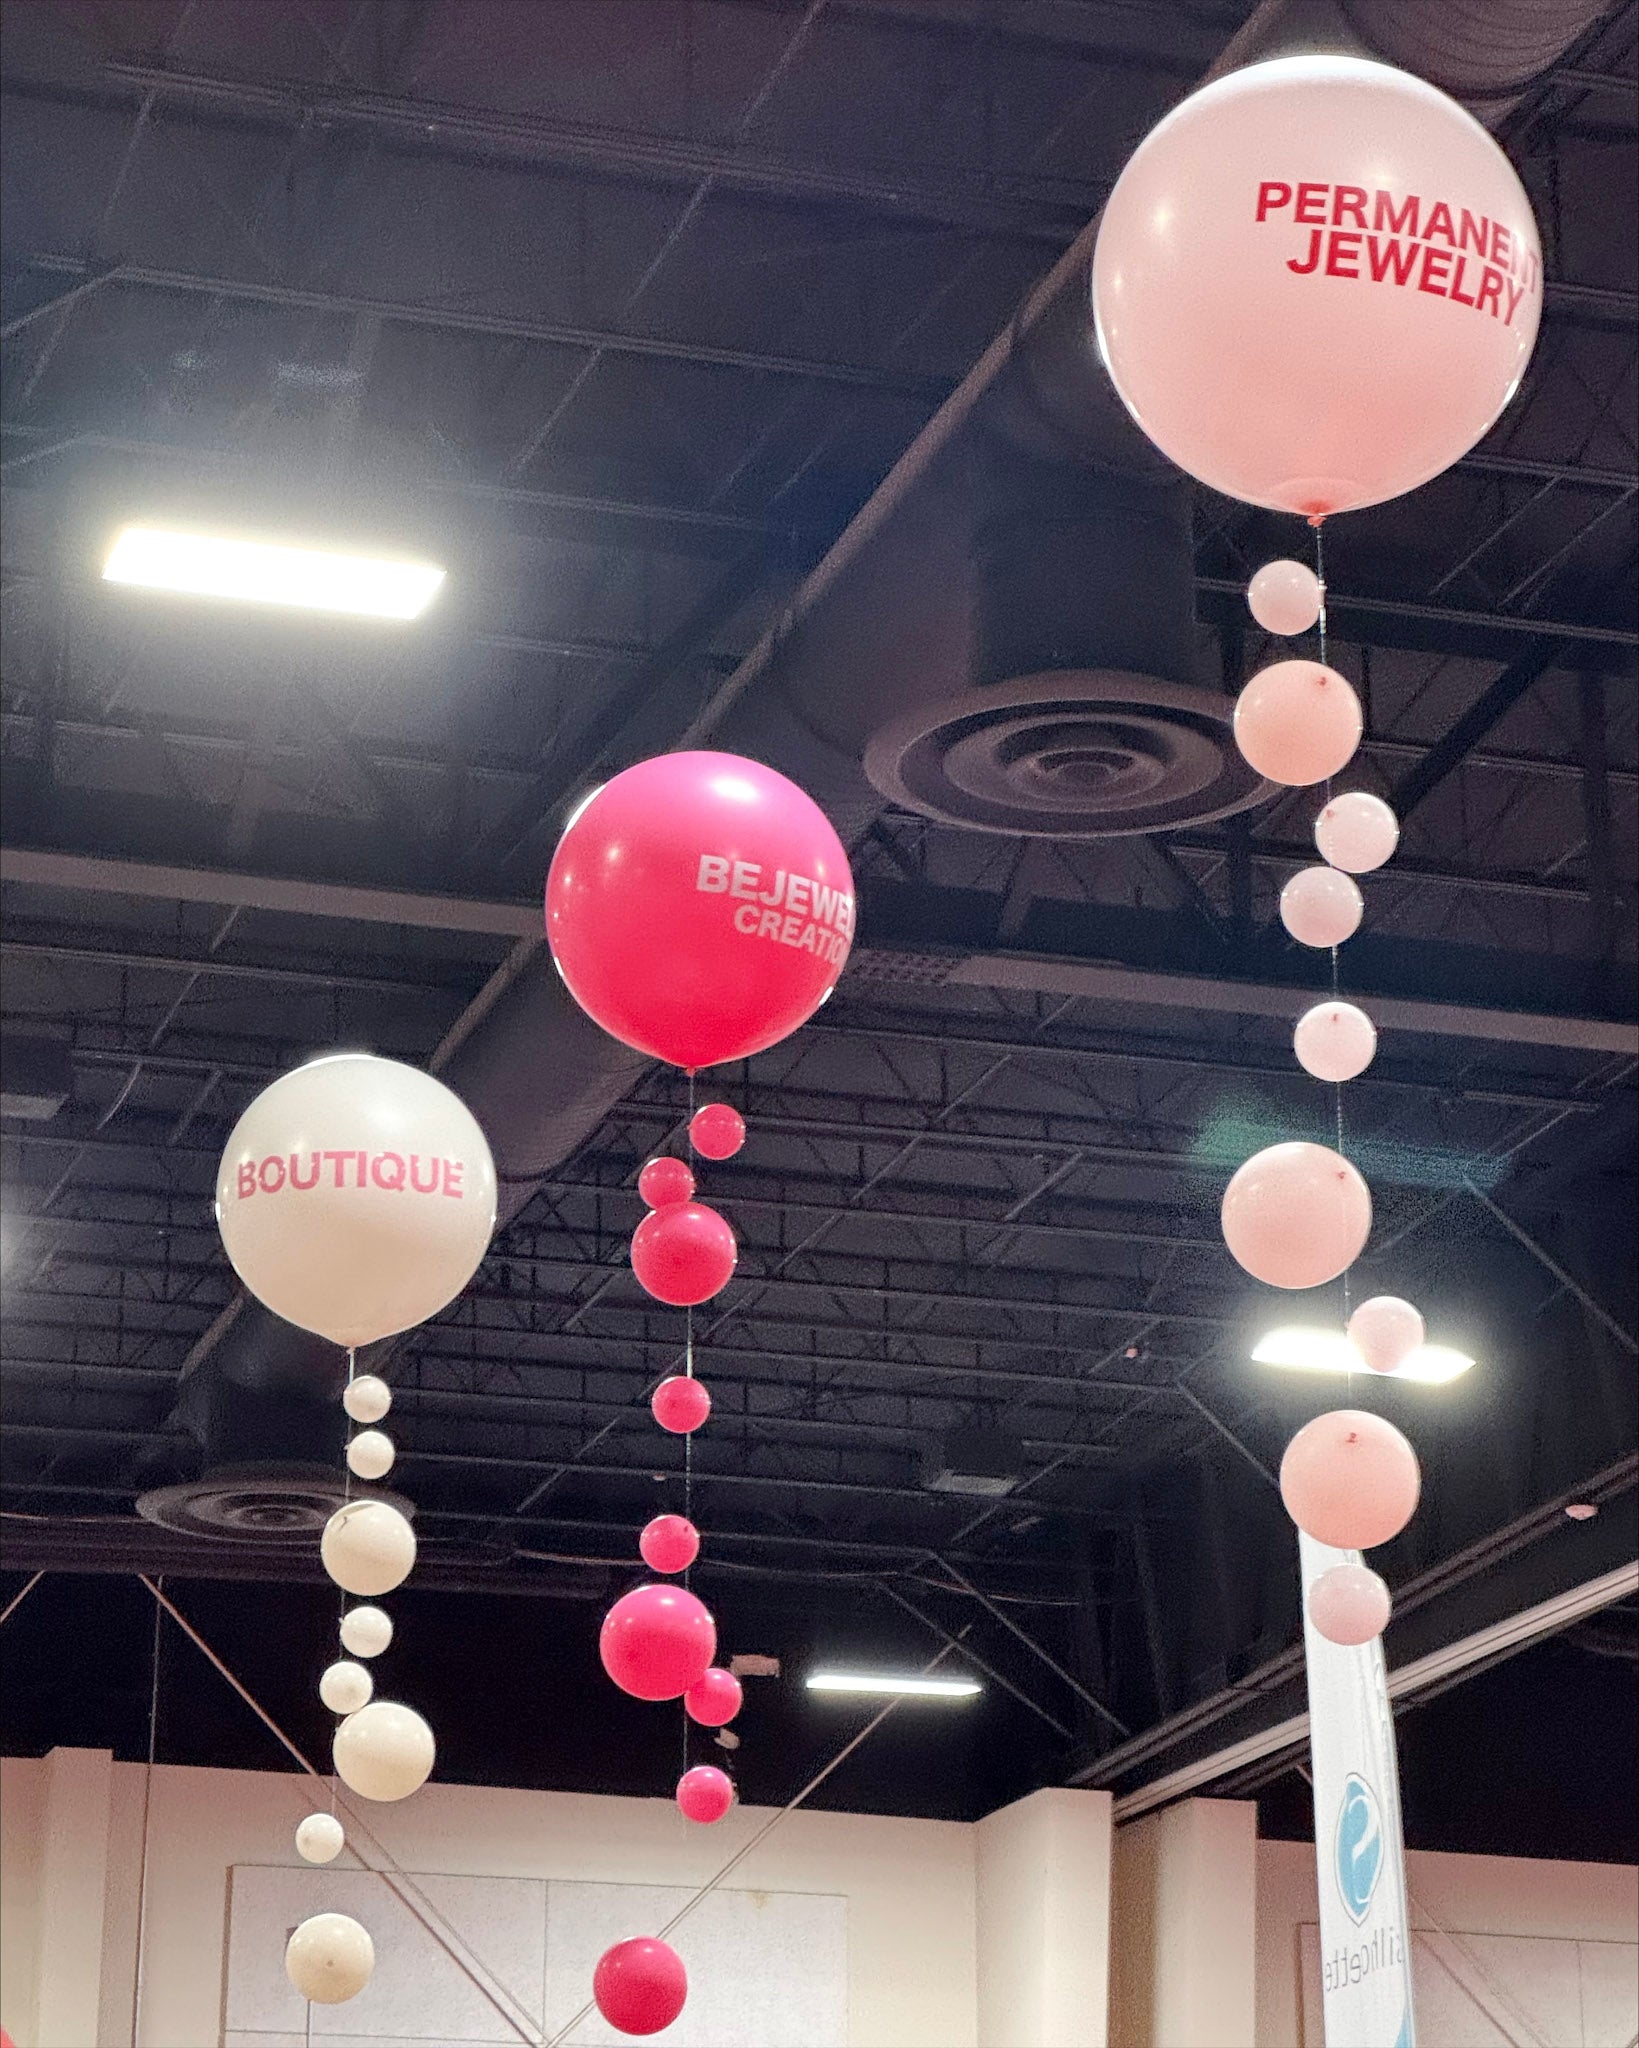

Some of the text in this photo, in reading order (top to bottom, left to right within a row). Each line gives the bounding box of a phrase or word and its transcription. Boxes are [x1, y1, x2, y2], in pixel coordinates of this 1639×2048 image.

[1286, 229, 1524, 326] JEWELRY
[734, 904, 851, 966] CREATIO
[237, 1150, 464, 1200] BOUTIQUE
